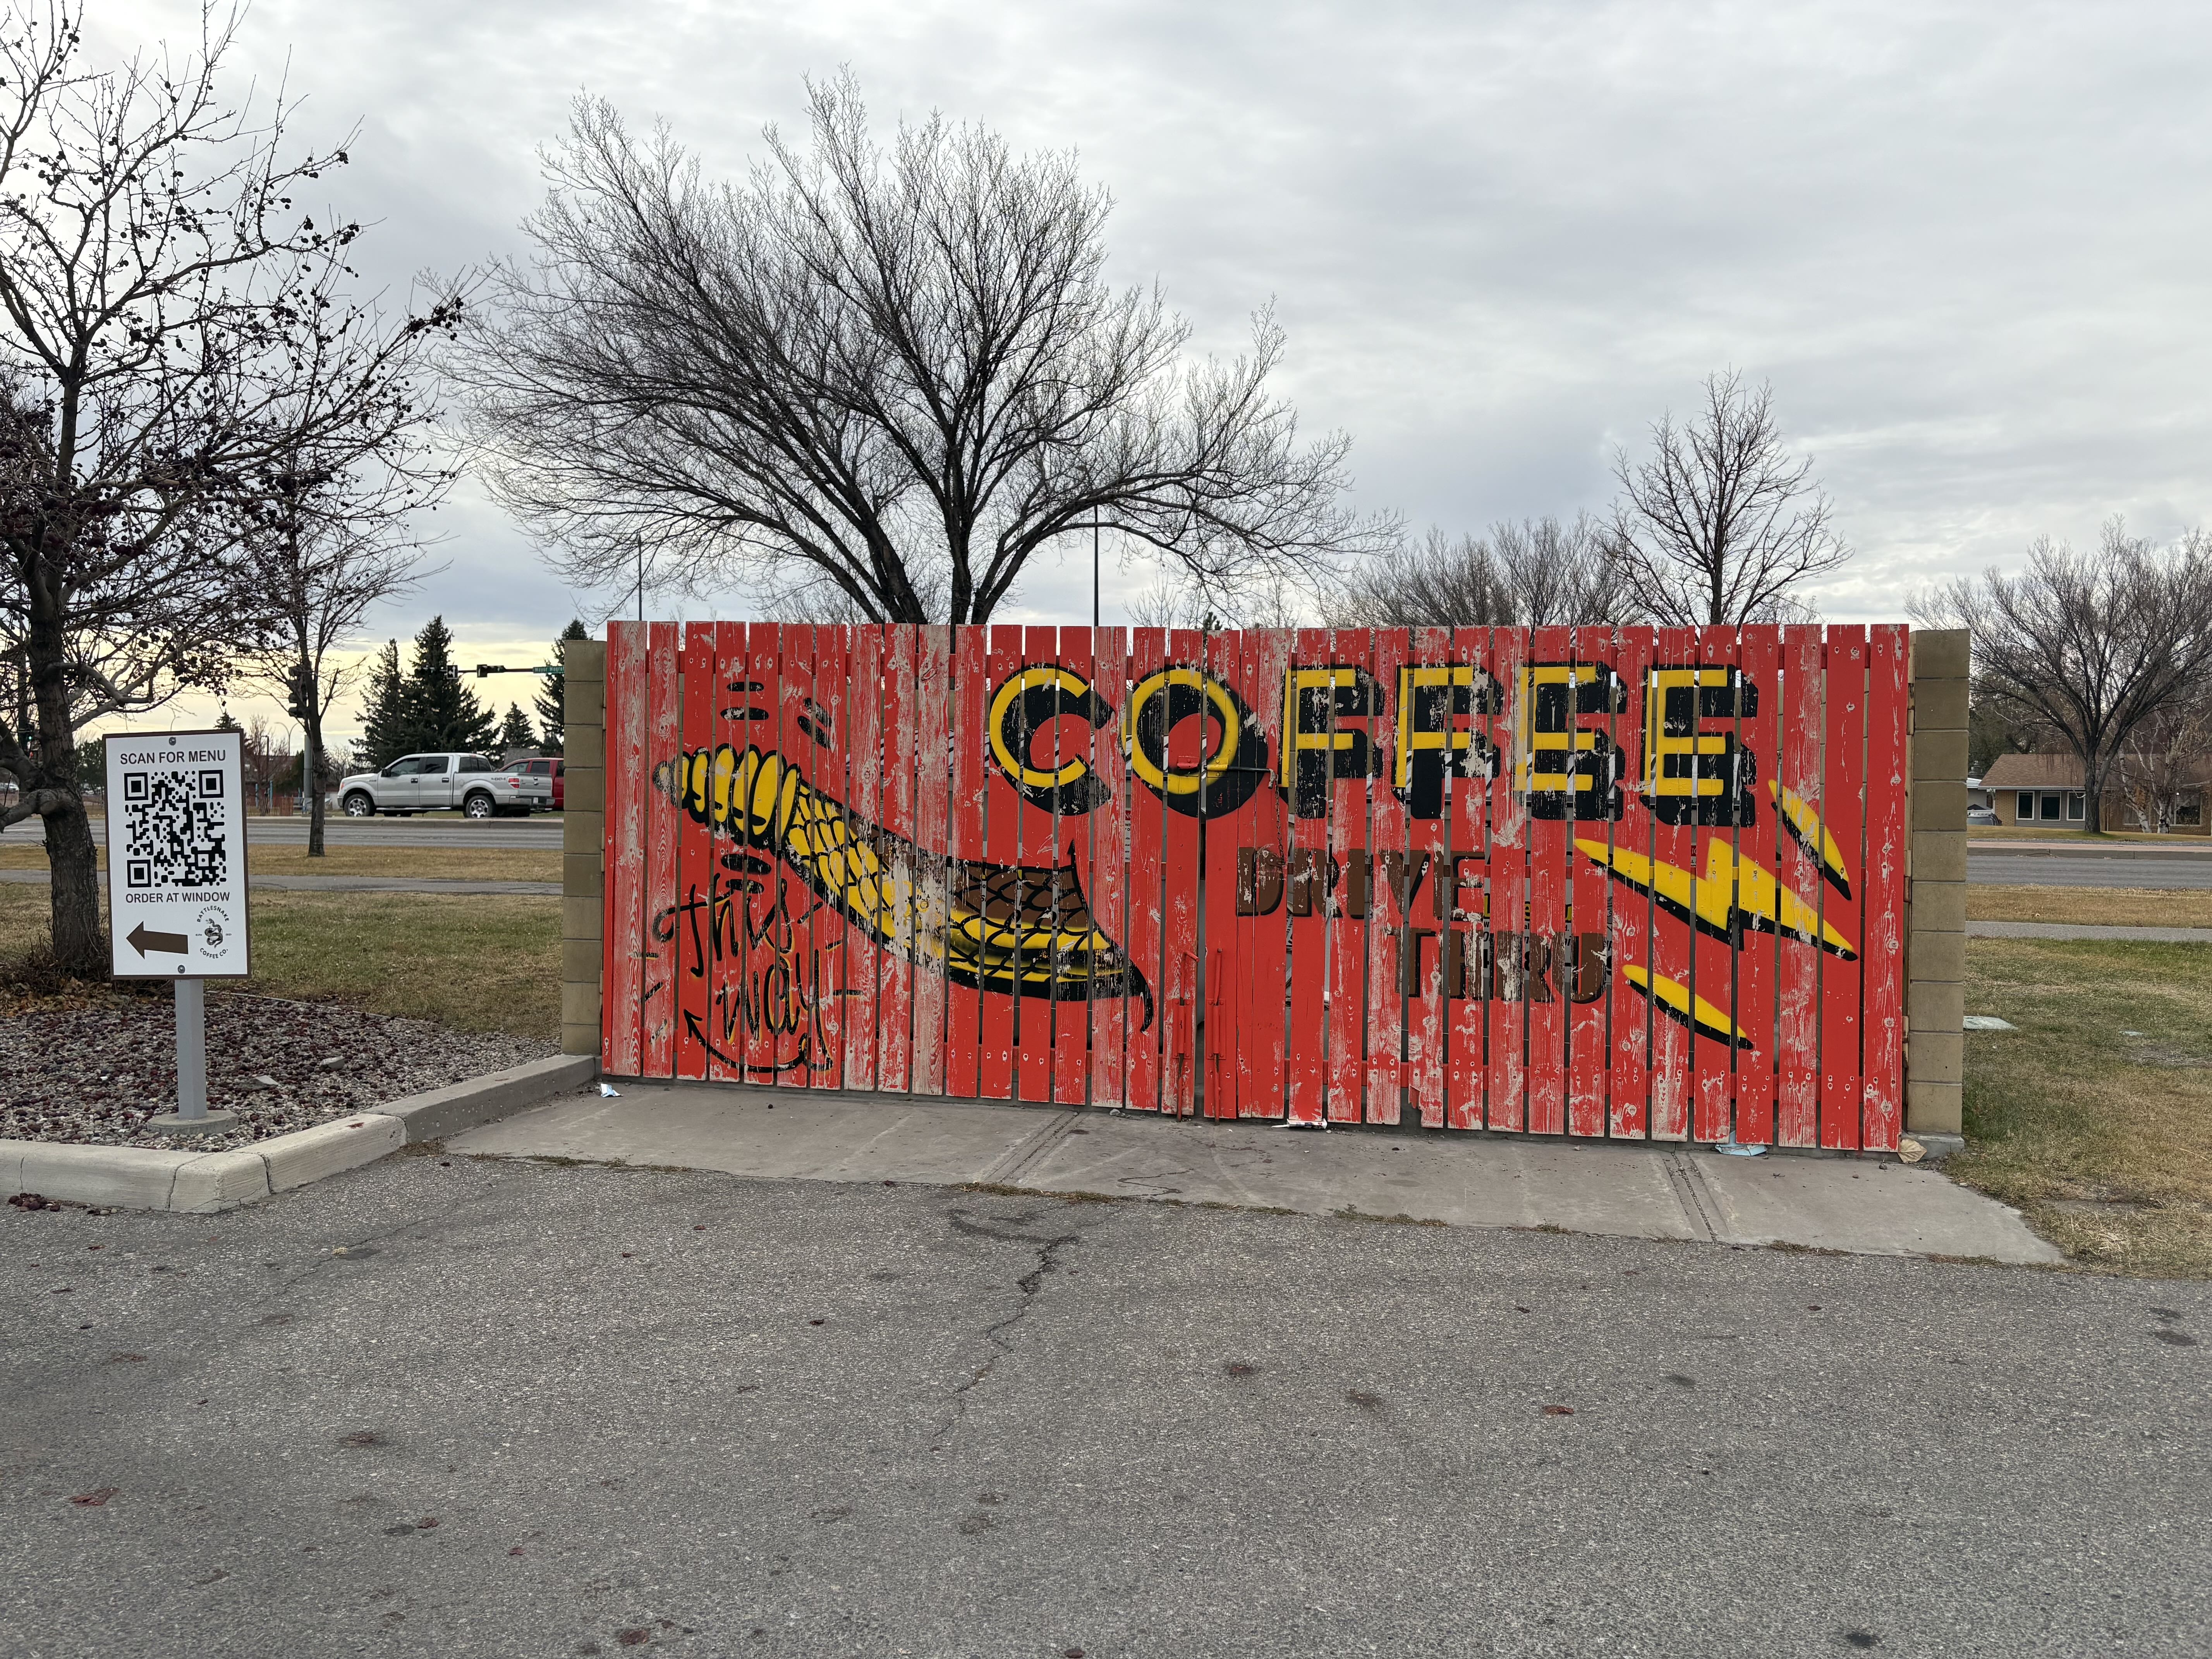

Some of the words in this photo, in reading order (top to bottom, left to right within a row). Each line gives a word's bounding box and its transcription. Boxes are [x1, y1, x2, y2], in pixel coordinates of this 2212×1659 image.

[990, 661, 1759, 827] COFFEE
[120, 752, 155, 764] SCAN
[159, 751, 185, 763] FOR
[189, 750, 226, 762] MENU
[1237, 847, 1486, 921] DRIVE
[126, 893, 163, 903] ORDER
[166, 893, 179, 902] AT
[182, 892, 230, 902] WINDOW
[197, 905, 229, 922] RATTLESNAKE
[200, 948, 219, 958] COFFEE
[1388, 927, 1606, 1004] THRU
